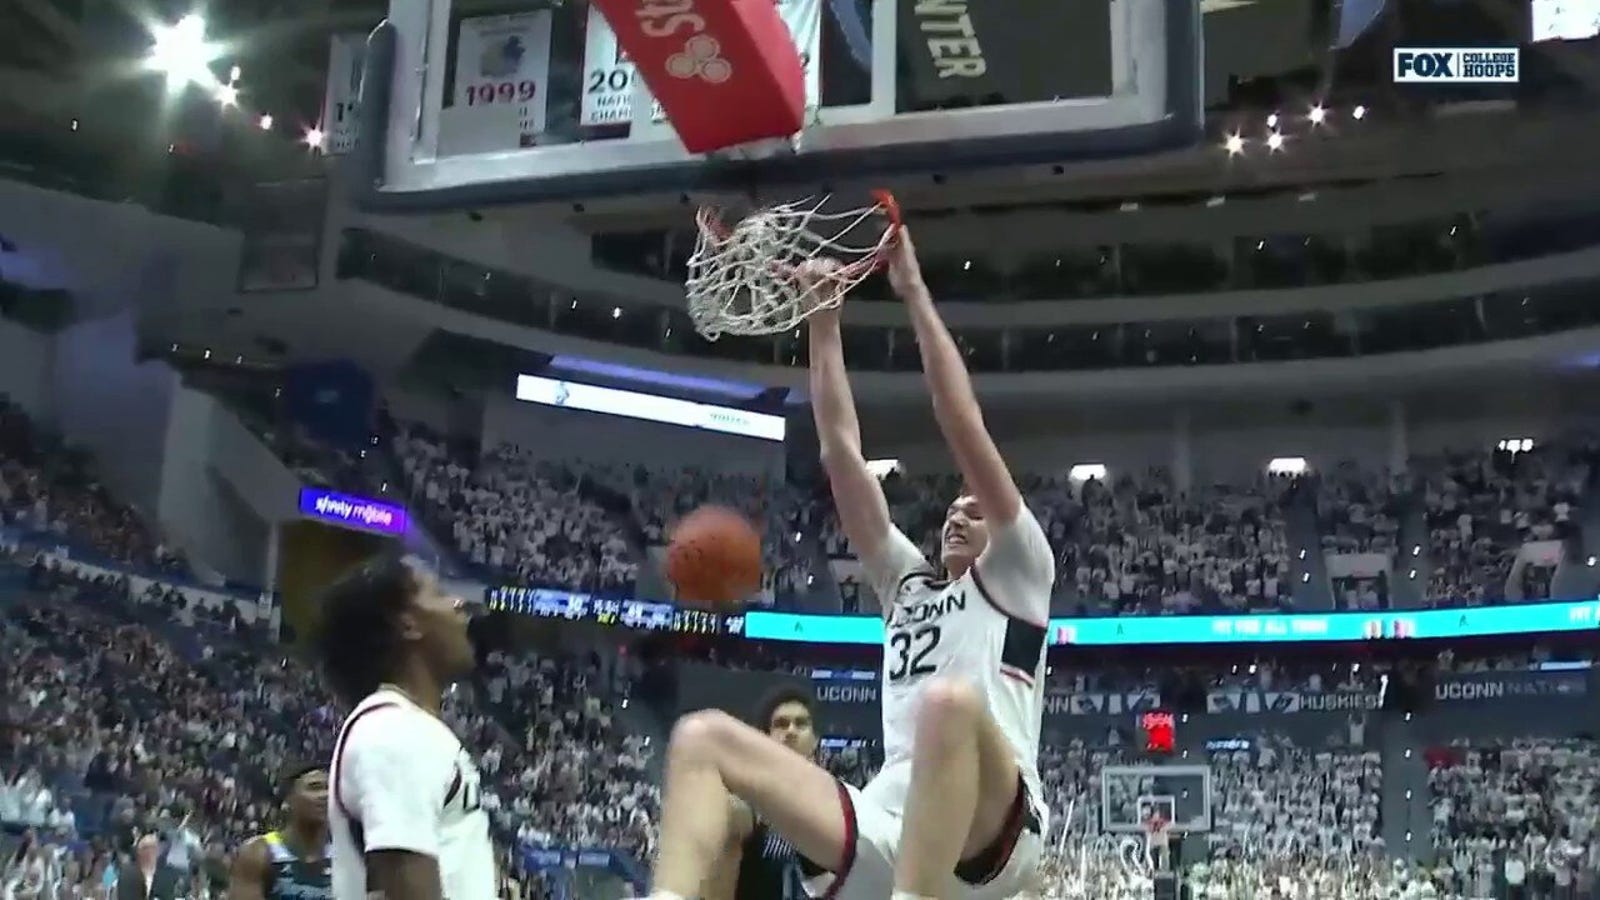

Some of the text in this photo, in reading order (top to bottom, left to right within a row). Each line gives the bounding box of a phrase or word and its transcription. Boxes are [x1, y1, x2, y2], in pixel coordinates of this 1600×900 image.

[466, 80, 536, 106] 1999
[890, 626, 940, 680] 32
[816, 686, 876, 703] UCONN
[1435, 682, 1503, 700] UCONN
[1301, 695, 1377, 710] HUSKIES
